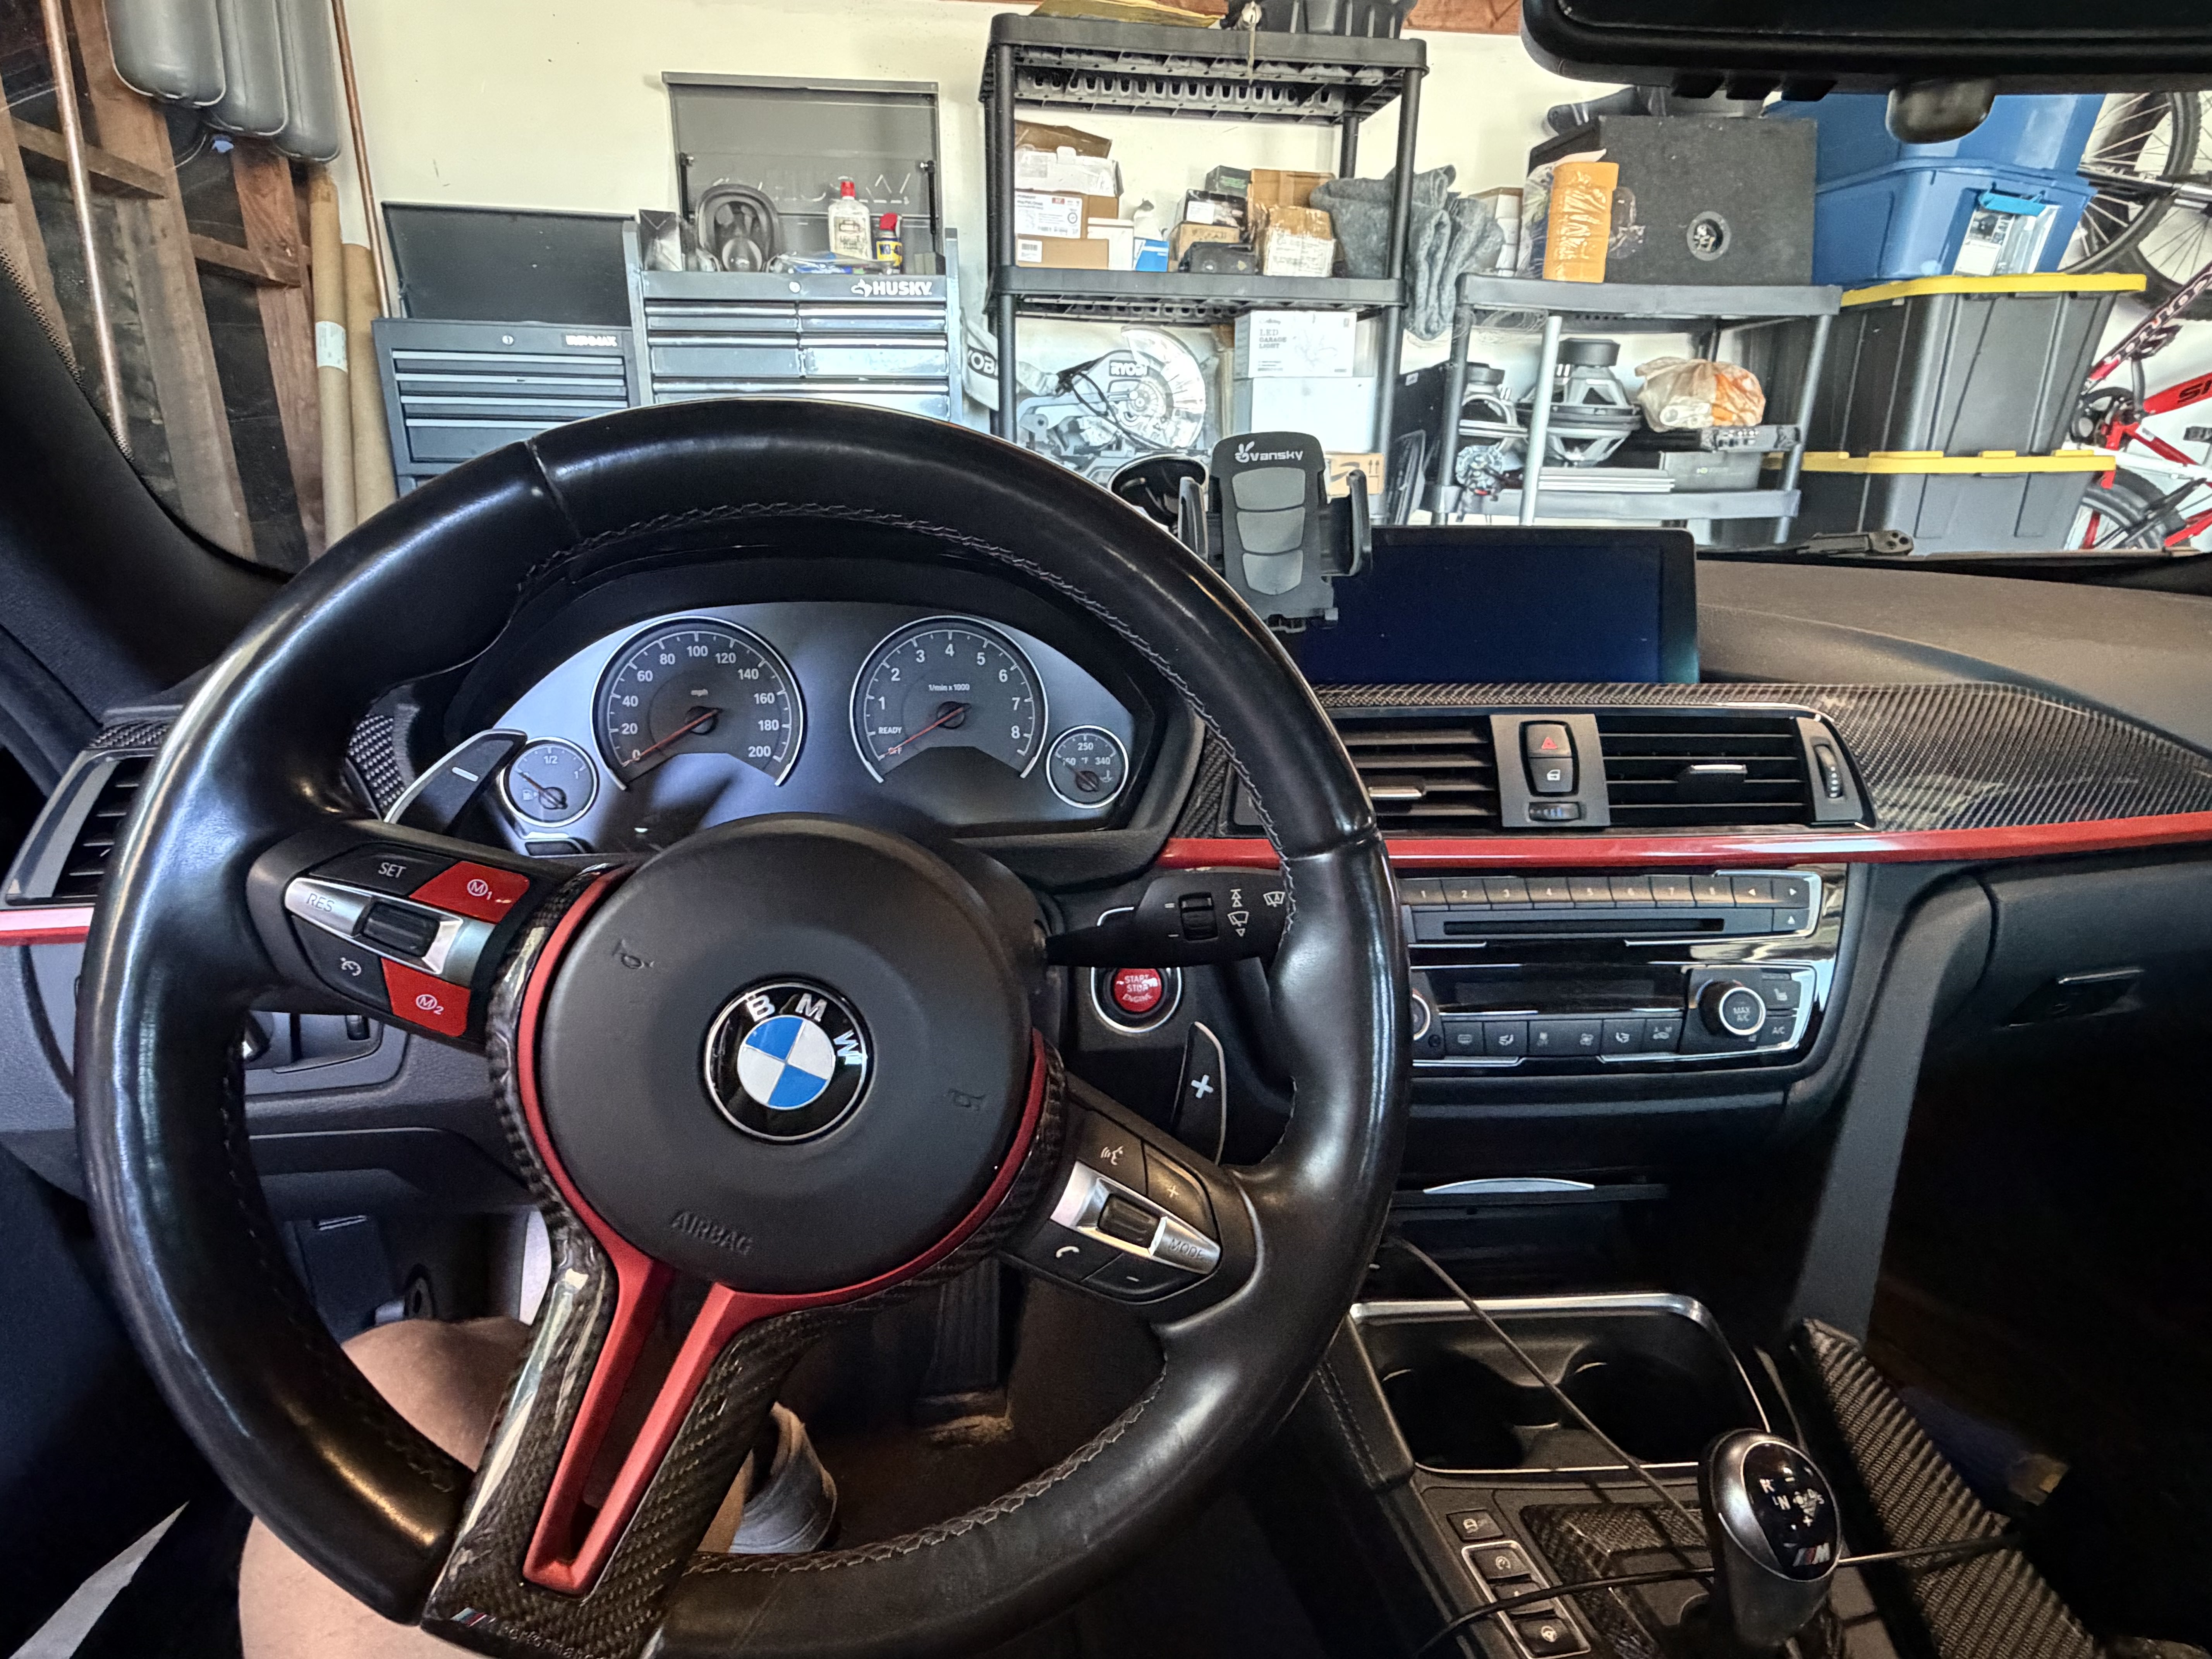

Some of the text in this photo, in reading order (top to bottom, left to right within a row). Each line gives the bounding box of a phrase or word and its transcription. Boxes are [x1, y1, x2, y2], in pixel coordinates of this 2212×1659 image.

[873, 281, 932, 295] HUSKY
[1250, 450, 1304, 461] vansky
[687, 646, 708, 657] 100
[945, 644, 955, 656] 4
[659, 653, 676, 665] 80
[715, 653, 737, 664] 120
[916, 650, 926, 663] 3
[976, 653, 986, 665] 5
[637, 670, 653, 682] 60
[738, 668, 759, 680] 140
[891, 668, 901, 681] 2
[998, 670, 1008, 682] 6
[690, 689, 708, 697] mph
[754, 692, 775, 704] 160
[622, 695, 639, 708] 40
[878, 697, 886, 709] 1
[1012, 697, 1021, 710] 7
[622, 723, 638, 735] 20
[758, 719, 779, 731] 180
[878, 726, 902, 735] READY
[1011, 726, 1020, 739] 8
[748, 745, 771, 757] 200
[1077, 742, 1094, 751] 250
[544, 756, 558, 764] 1/2
[1094, 757, 1111, 765] 340
[574, 771, 579, 779] 1
[378, 862, 406, 878] SET
[1421, 890, 1426, 898] 1
[1462, 890, 1468, 899] 2
[1503, 889, 1510, 898] 3
[1546, 888, 1552, 896] 4
[306, 893, 335, 912] RES
[1127, 984, 1149, 992] STOP
[1772, 1026, 1786, 1034] A/C
[670, 1210, 753, 1254] AIRBAG
[1170, 1238, 1204, 1259] MODE
[1777, 1495, 1791, 1510] N
